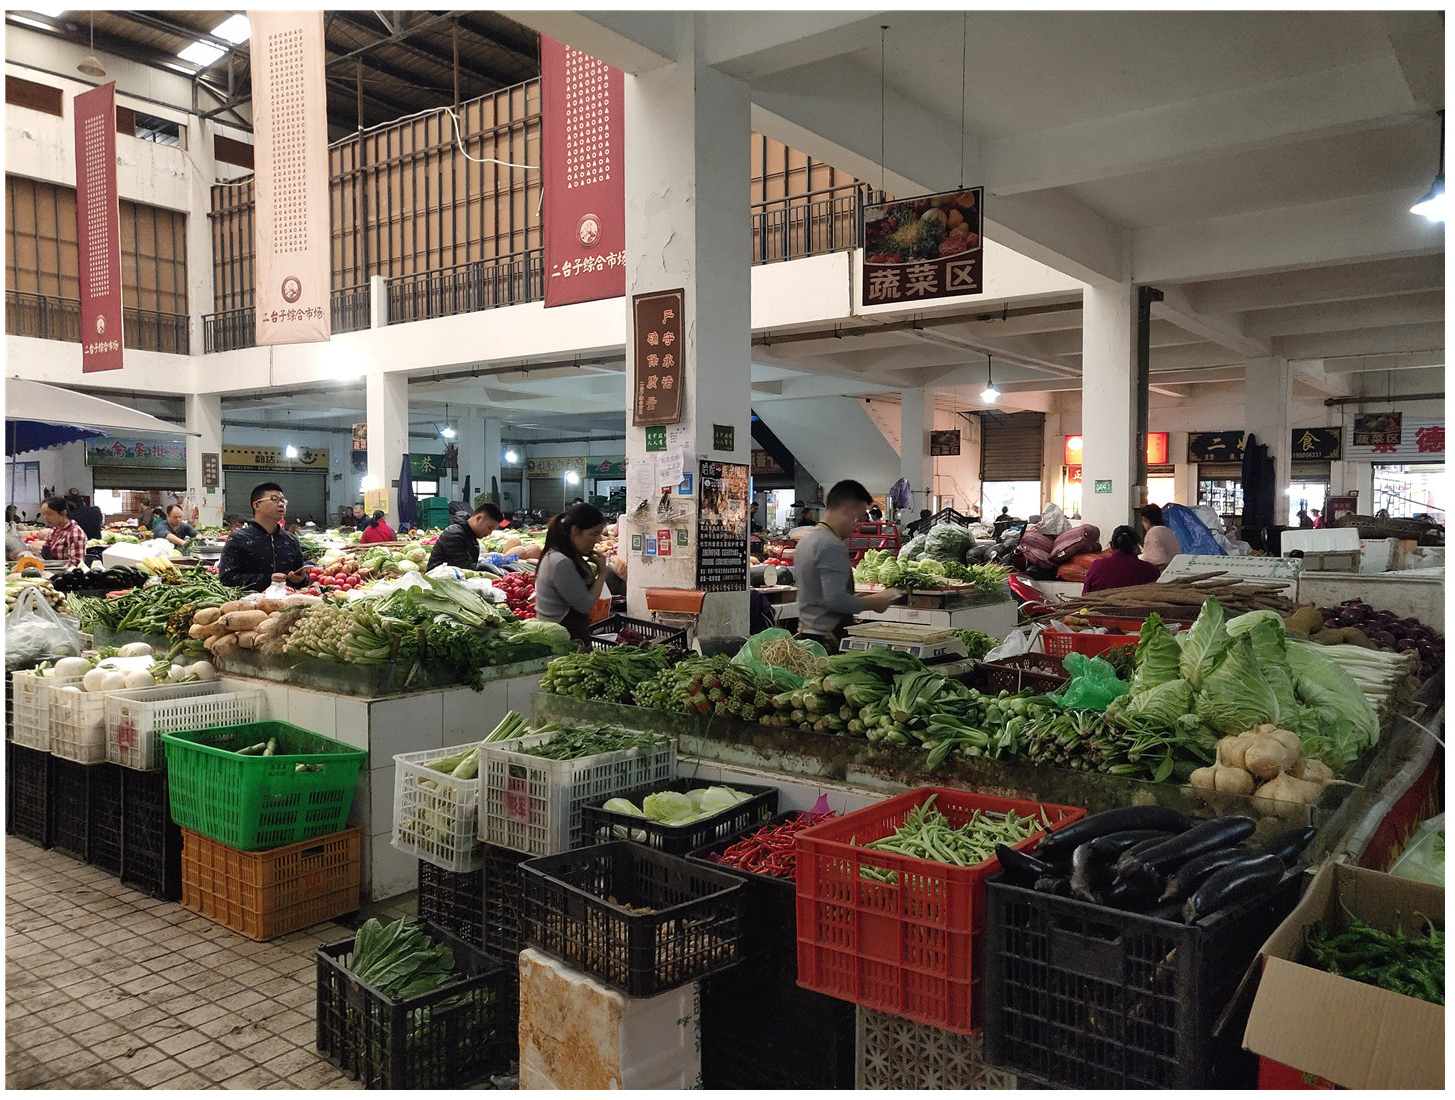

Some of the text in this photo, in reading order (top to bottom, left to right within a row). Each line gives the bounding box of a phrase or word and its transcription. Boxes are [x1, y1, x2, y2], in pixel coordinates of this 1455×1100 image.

[868, 259, 977, 300] 蔬菜区
[262, 306, 324, 324] 二台子综合市场
[84, 340, 119, 355] 二台子综合市场
[661, 309, 675, 389] 严守承诺
[646, 331, 659, 410] 确保质量
[1297, 430, 1321, 450] 食
[1355, 432, 1401, 445] 蔬菜区
[419, 455, 436, 473] 茶
